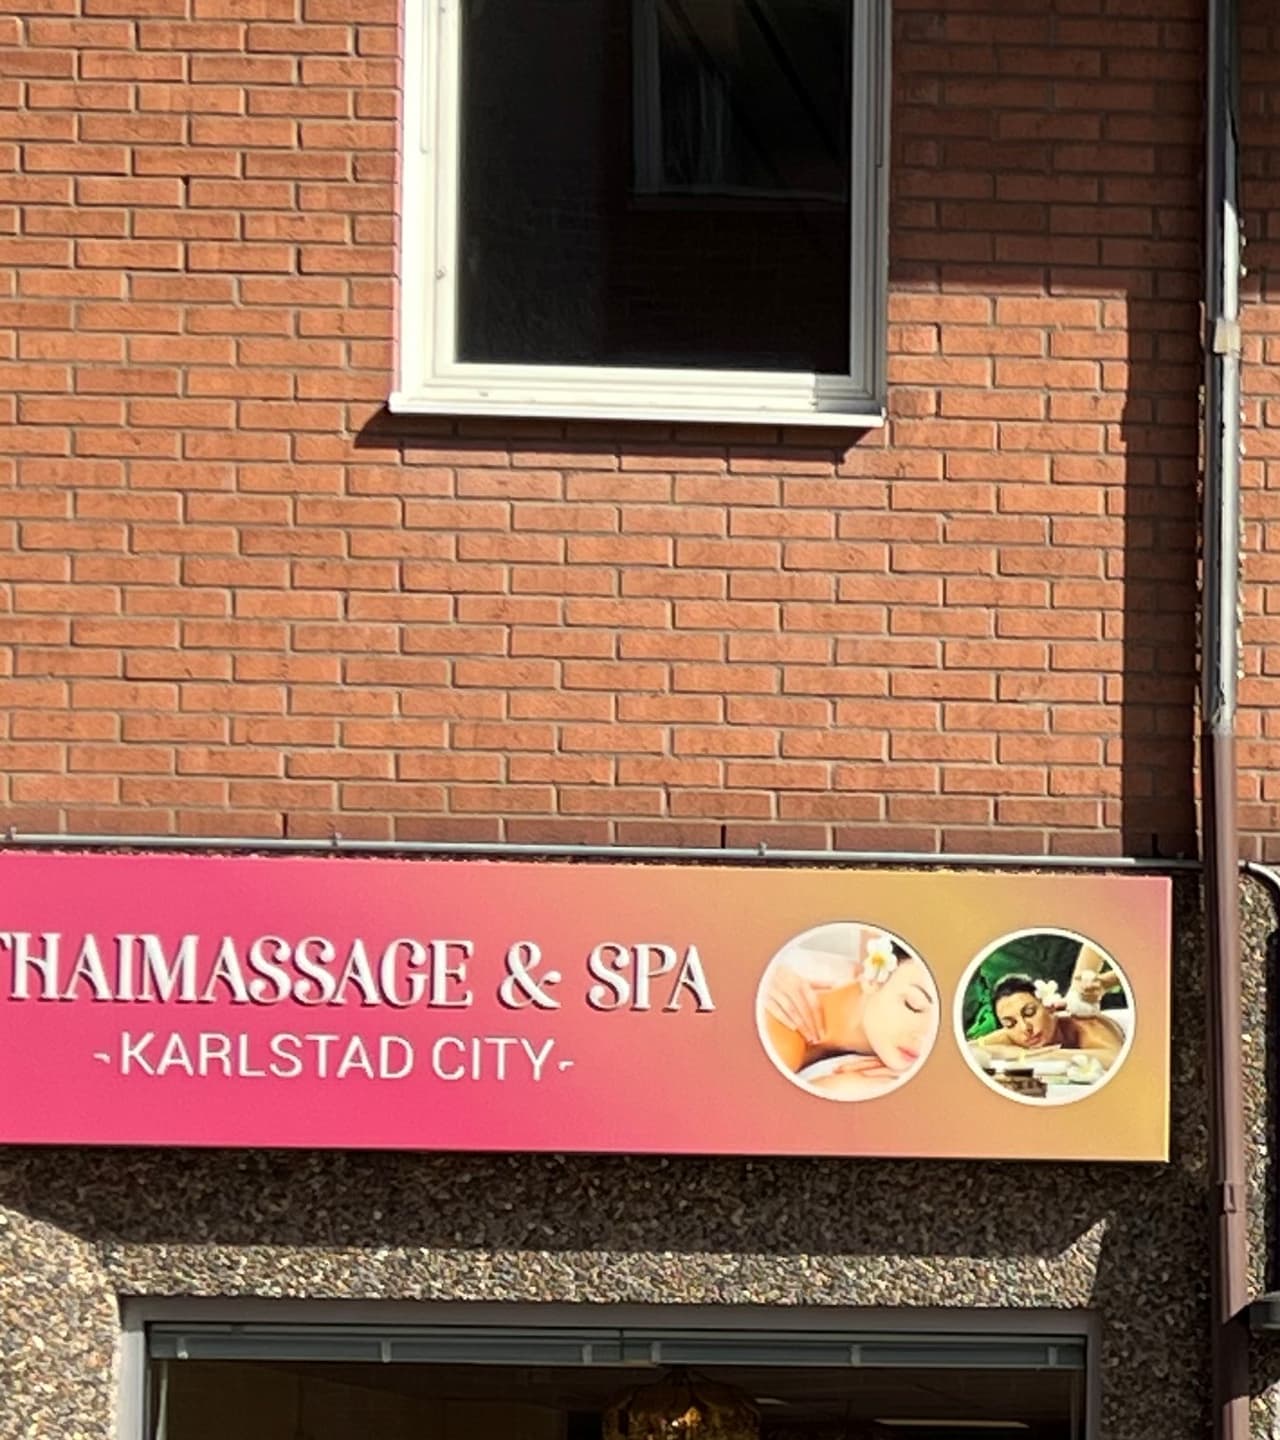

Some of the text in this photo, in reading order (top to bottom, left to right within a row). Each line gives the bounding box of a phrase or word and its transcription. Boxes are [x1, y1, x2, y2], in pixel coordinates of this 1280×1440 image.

[0, 932, 716, 1013] HAIMASSAGE & SPA
